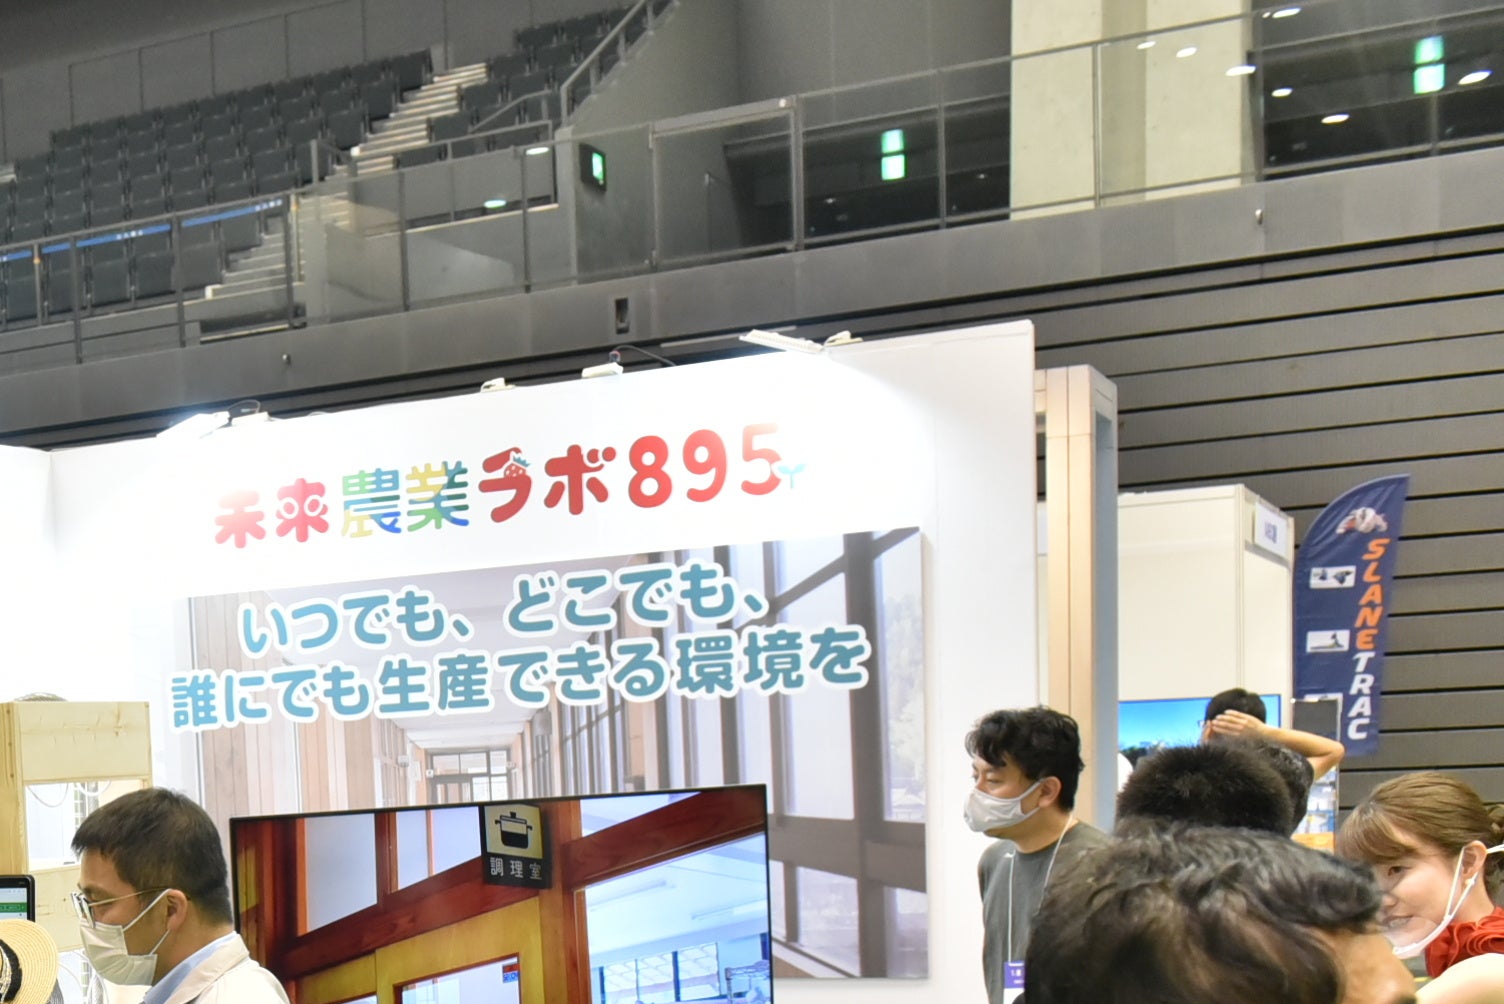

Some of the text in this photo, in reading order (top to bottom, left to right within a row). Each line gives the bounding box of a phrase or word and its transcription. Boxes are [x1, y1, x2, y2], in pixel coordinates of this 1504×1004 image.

[214, 422, 784, 548] 未来農業ラボ895
[171, 627, 866, 728] 誰にでも生産できる環境を
[1347, 538, 1391, 740] SLANETRAC
[489, 856, 543, 880] 調理室
